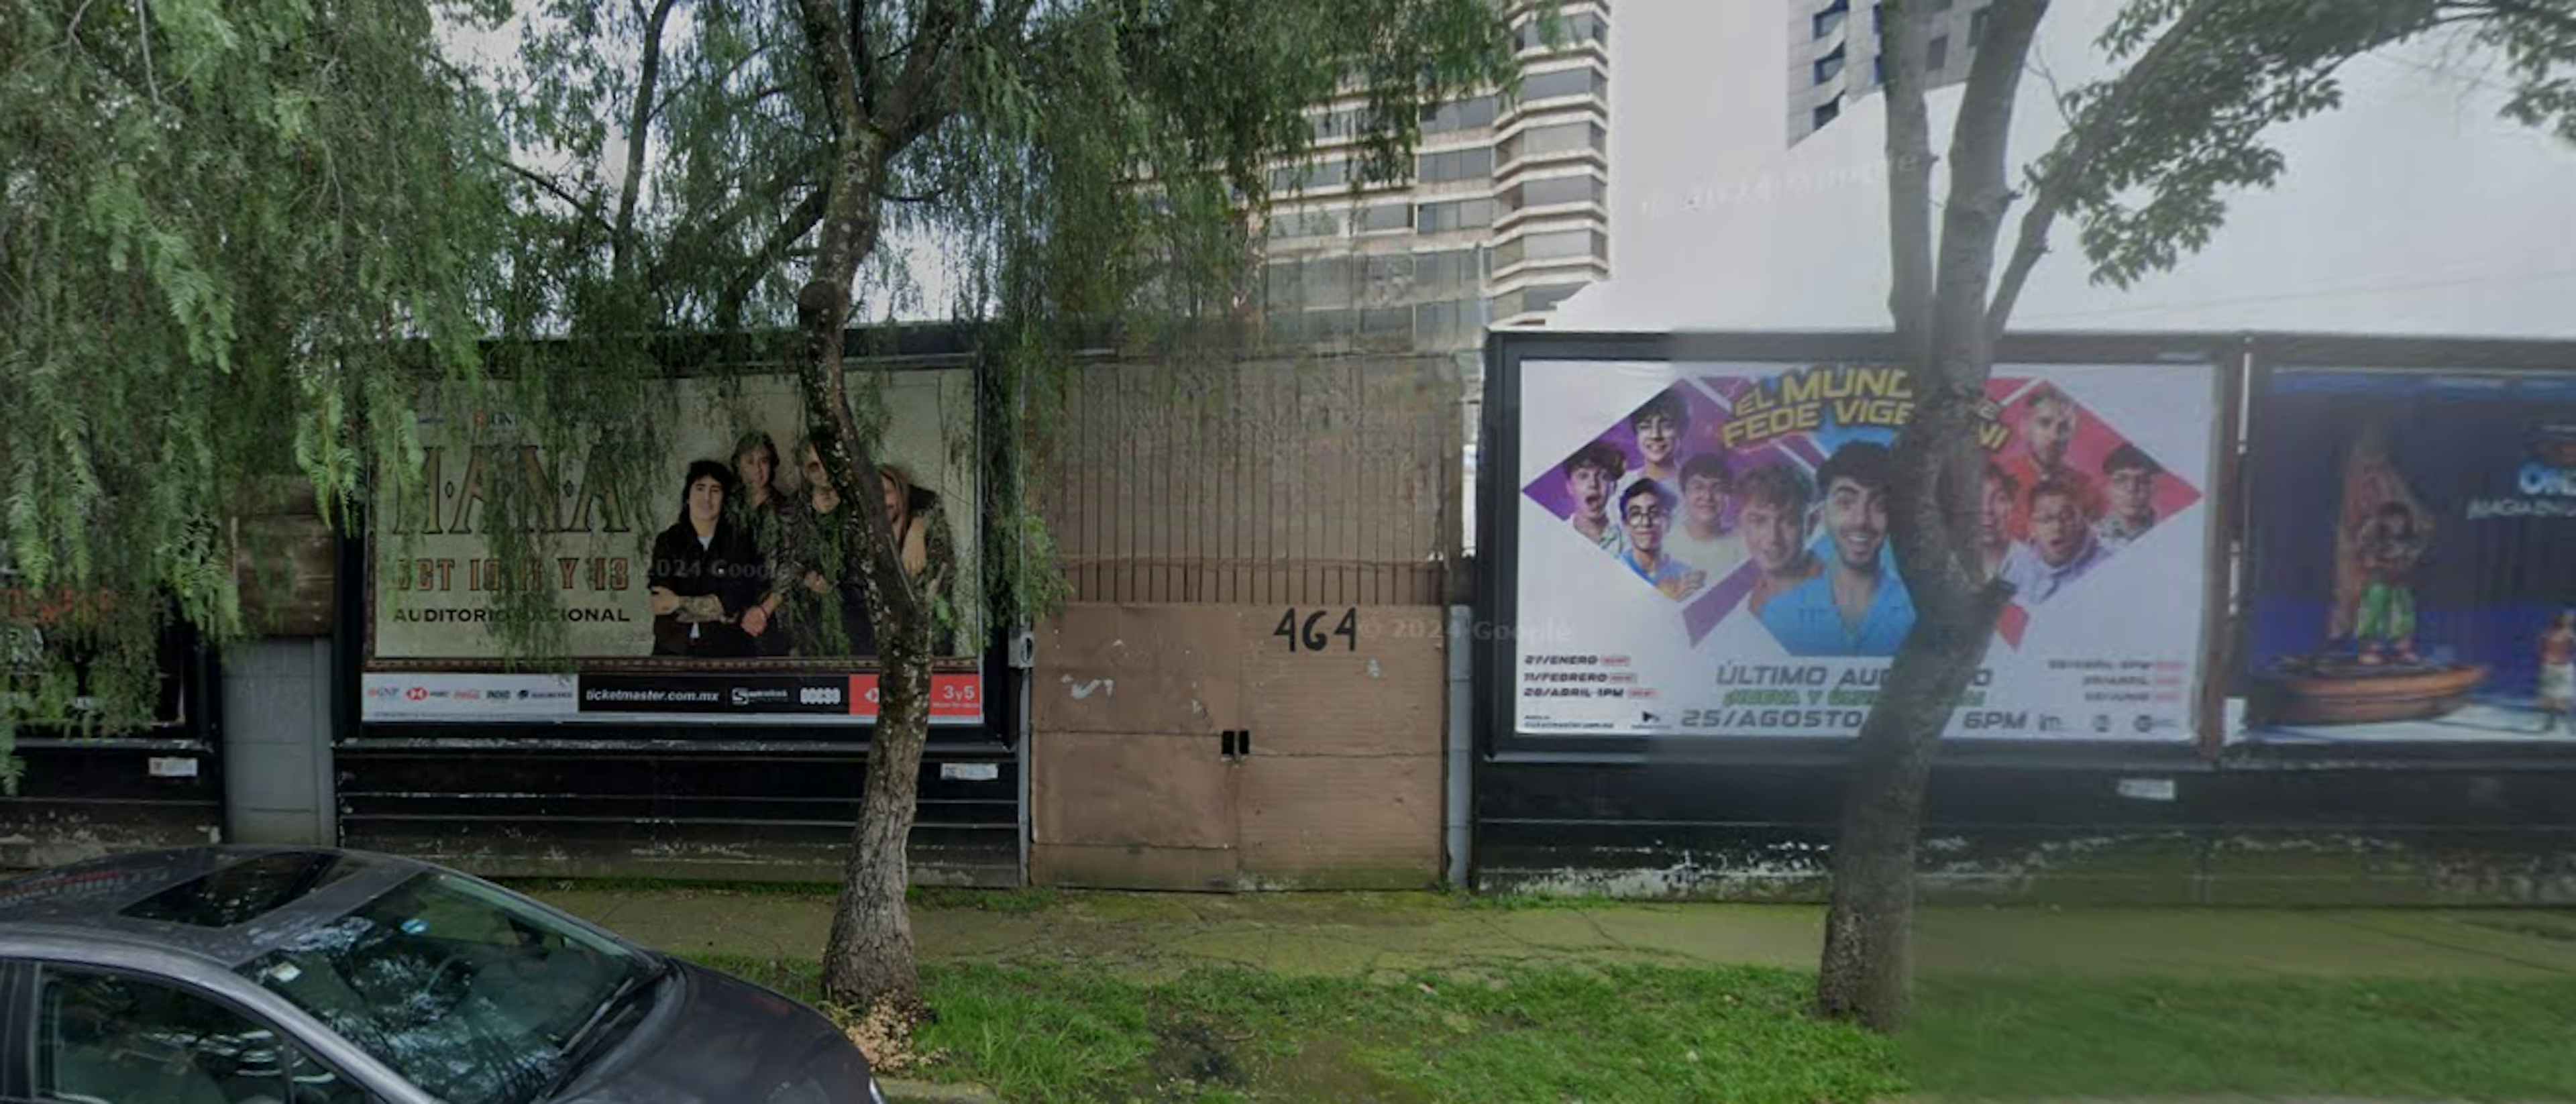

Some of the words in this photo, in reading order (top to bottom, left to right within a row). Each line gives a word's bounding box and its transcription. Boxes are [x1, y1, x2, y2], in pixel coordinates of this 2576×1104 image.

[1735, 388, 1775, 417] EL
[1781, 368, 1915, 402] MUND
[1722, 404, 1823, 450] FEDE
[557, 557, 580, 589] Y
[594, 557, 629, 591] 13
[1273, 607, 1357, 652] 464
[1716, 660, 1828, 685] ÚLTIMO
[586, 688, 720, 702] ticketmaster.com.mx
[1680, 709, 1864, 729] 25/AGOSTO
[1963, 710, 2027, 729] 6PM
